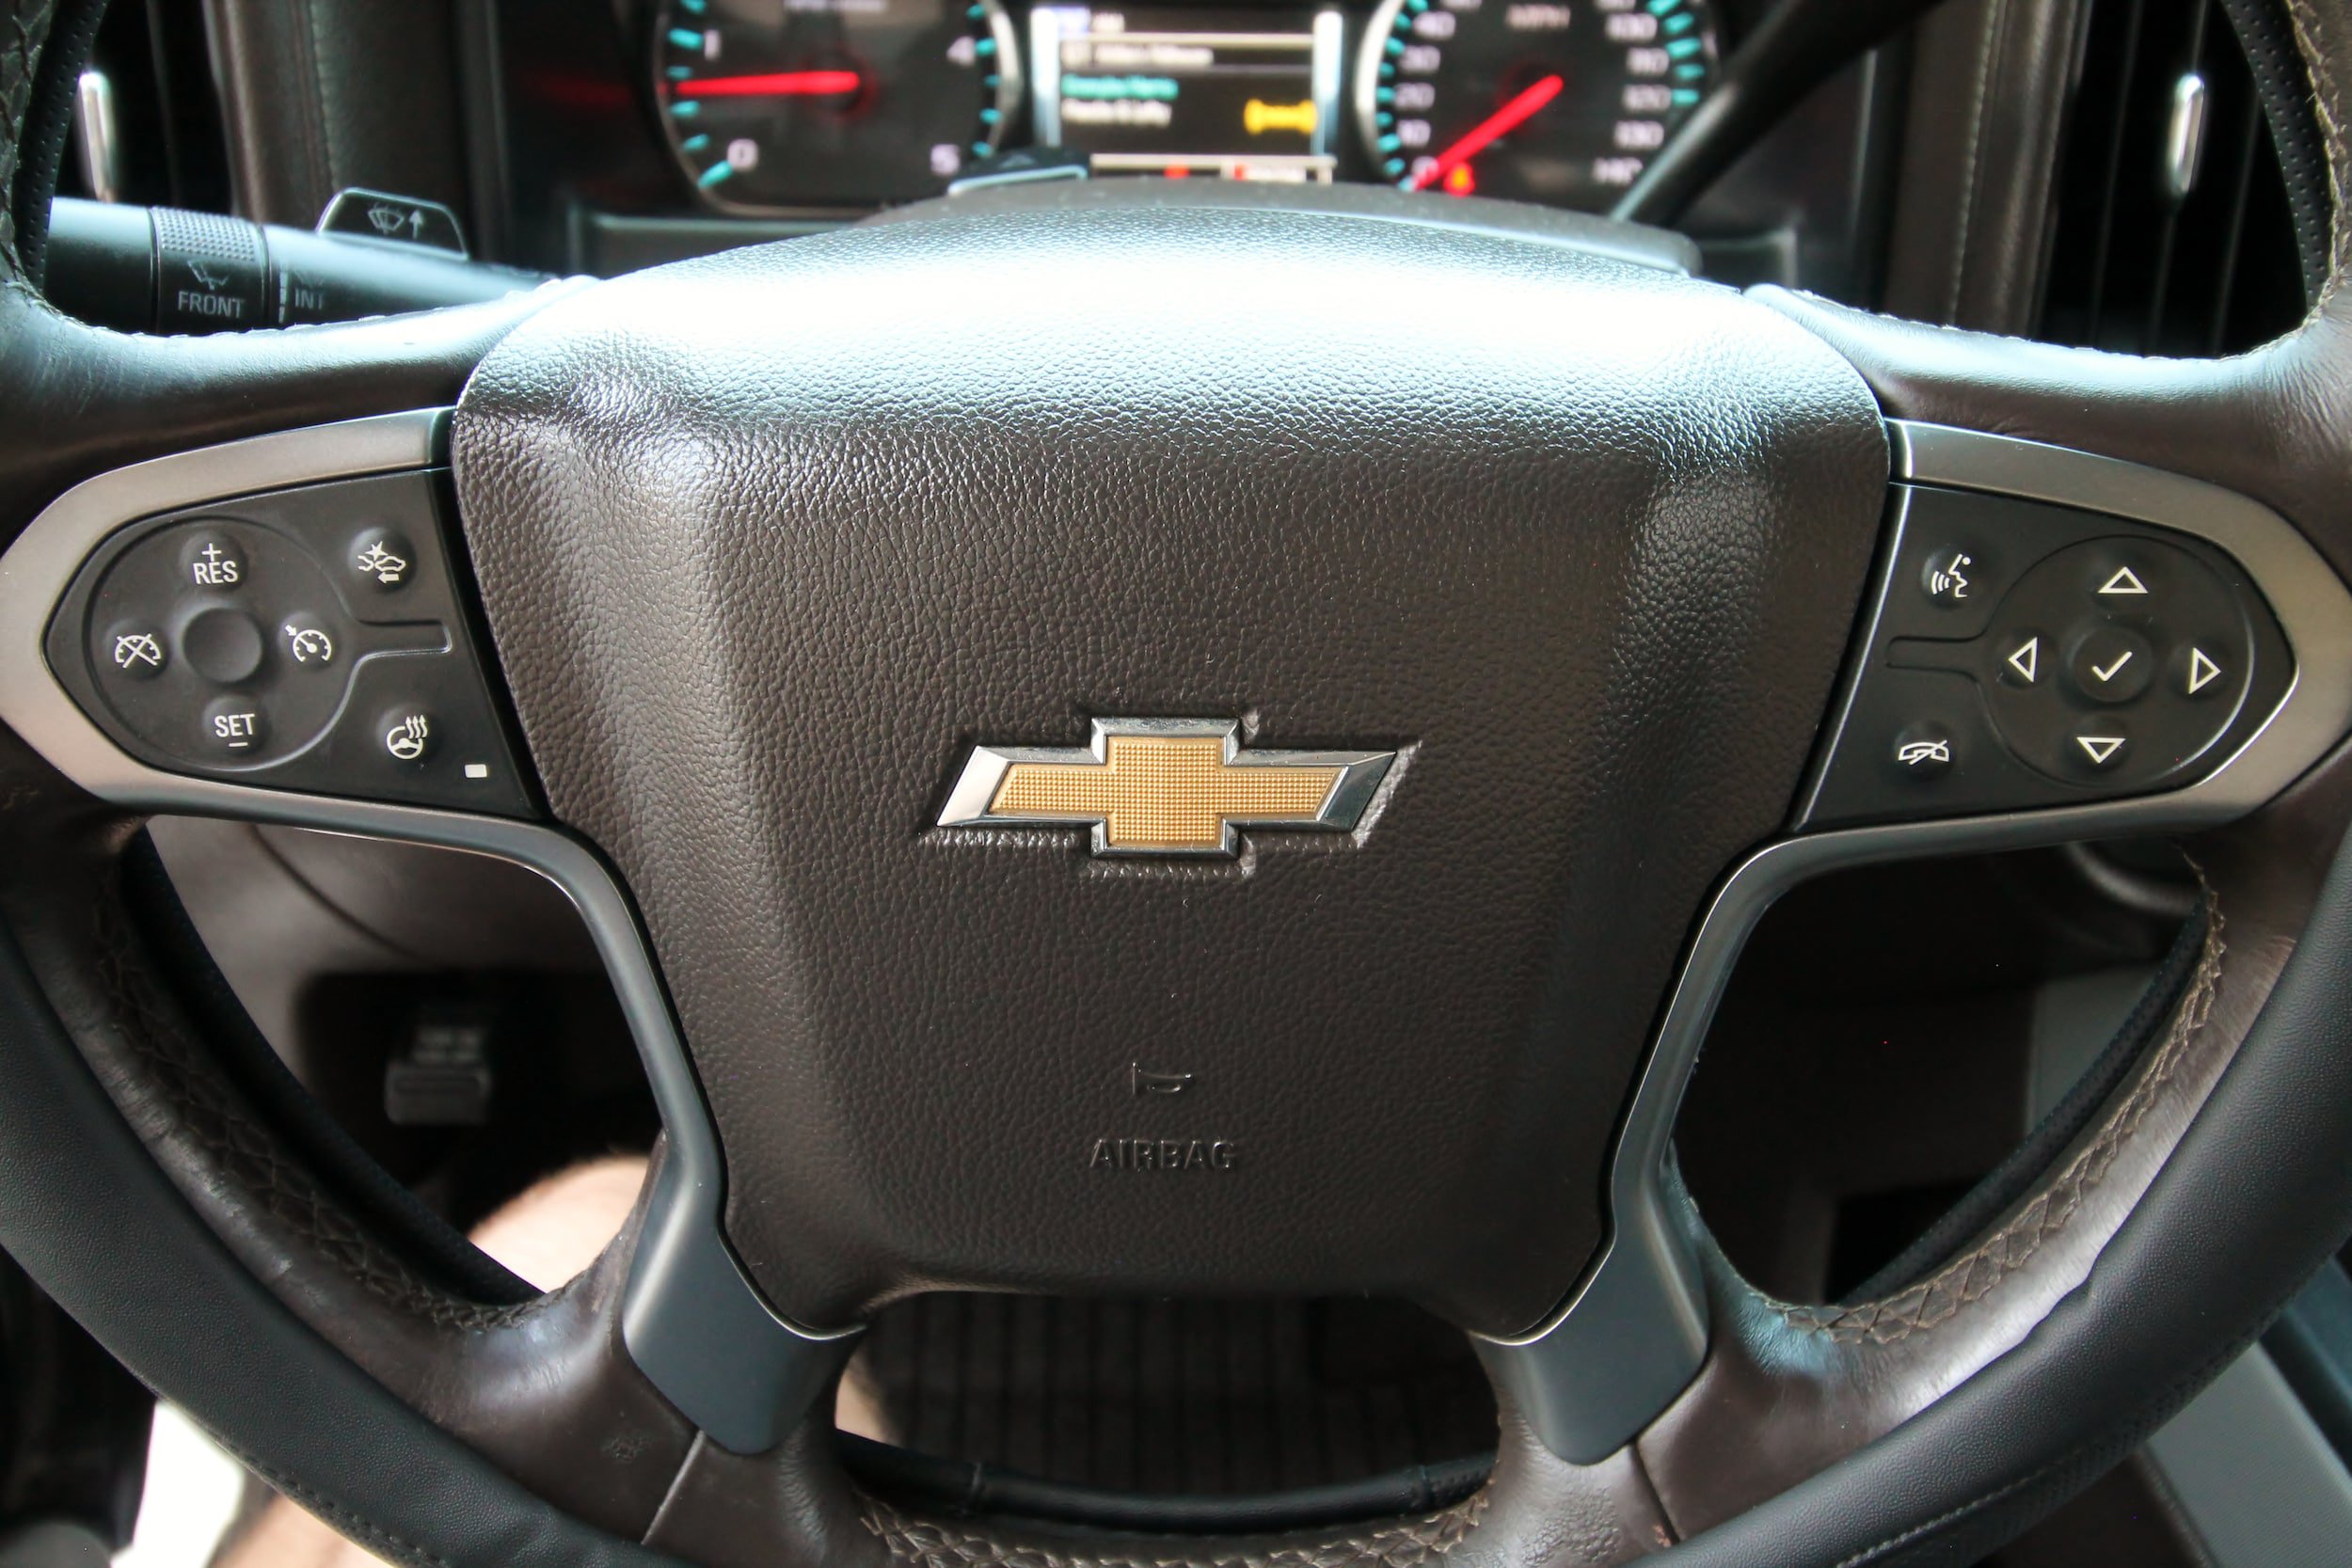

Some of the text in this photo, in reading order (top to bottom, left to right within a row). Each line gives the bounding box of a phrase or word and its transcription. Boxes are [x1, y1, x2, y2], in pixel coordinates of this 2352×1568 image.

[727, 138, 758, 171] 0
[177, 291, 245, 319] FRONT
[193, 561, 239, 586] RES
[215, 713, 256, 738] SET
[1089, 1138, 1236, 1170] AIRBAG
